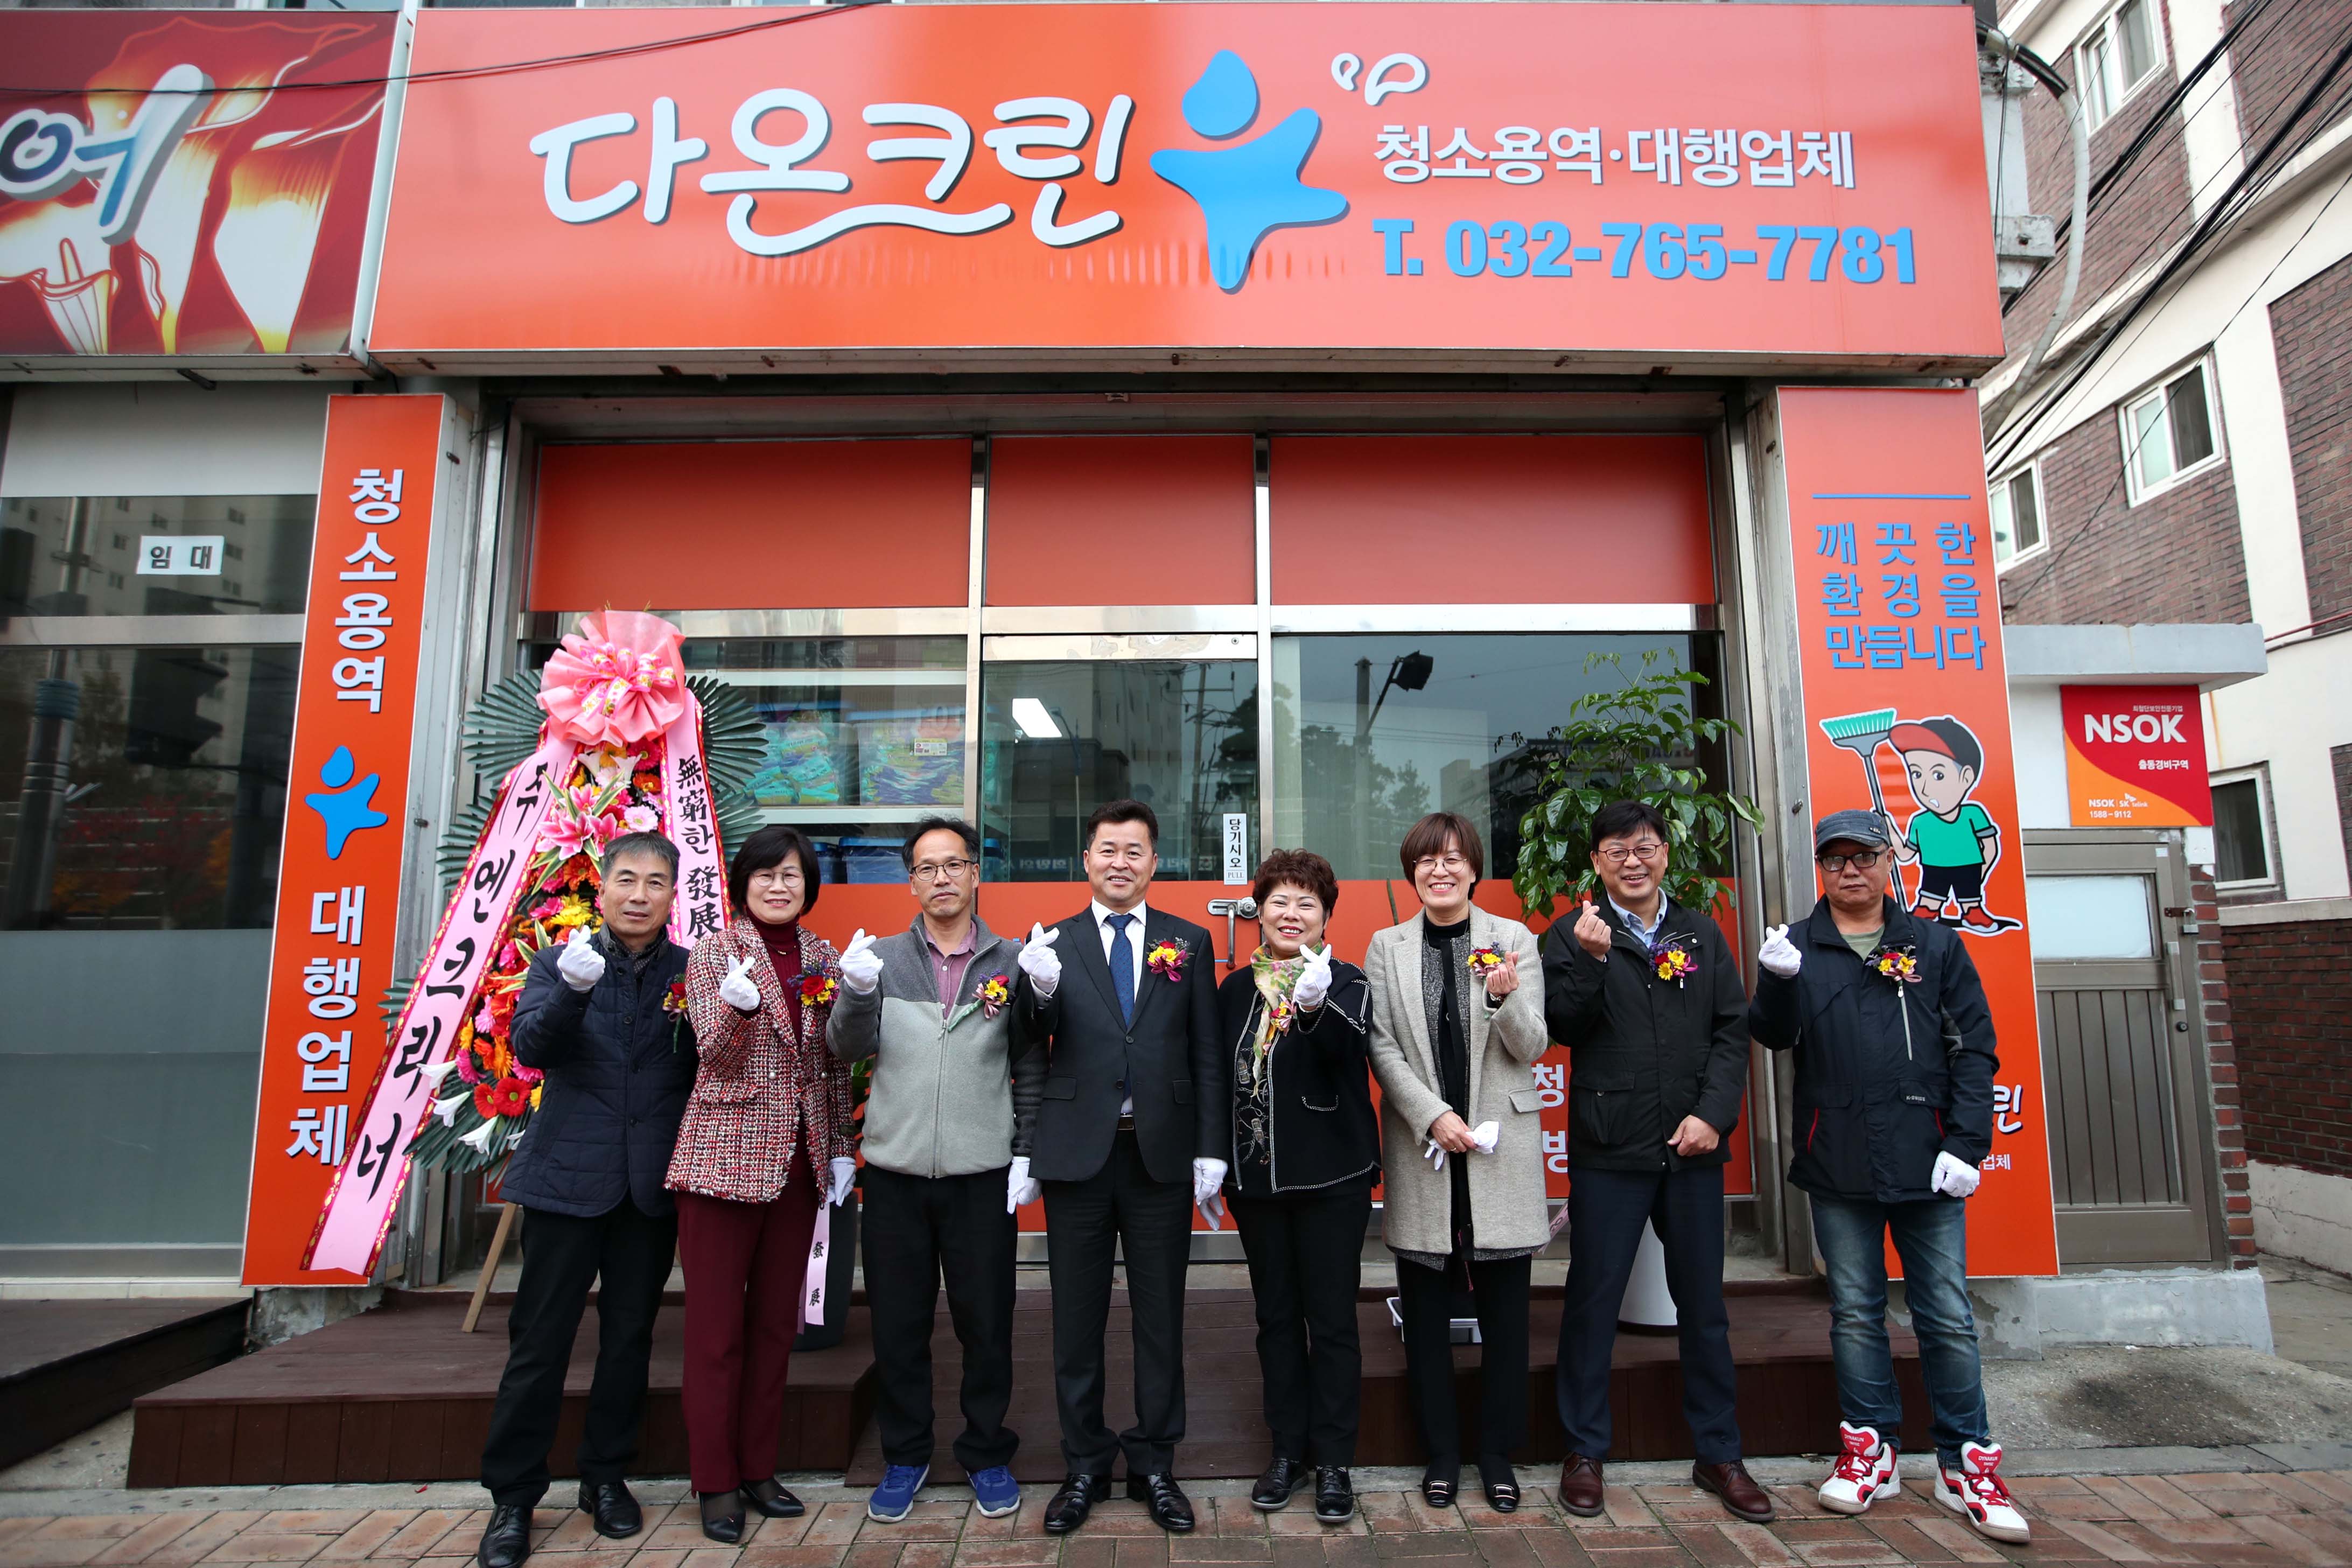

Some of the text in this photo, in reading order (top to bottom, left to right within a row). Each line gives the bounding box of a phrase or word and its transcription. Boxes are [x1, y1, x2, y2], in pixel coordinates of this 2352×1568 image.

[529, 87, 1134, 256] 다온크린
[1374, 124, 1855, 188] 청소용역·대행업체
[1373, 218, 1916, 283] T. 032-765-7781
[332, 468, 404, 713] 청소용역
[1824, 625, 1986, 670] 만듭니다
[2084, 713, 2187, 743] NSOK
[2089, 799, 2115, 808] NSOK
[2119, 800, 2130, 808] SK
[1229, 818, 1242, 867] 당기시오
[285, 885, 366, 1166] 대행업체
[1978, 1153, 2011, 1171] 업체
